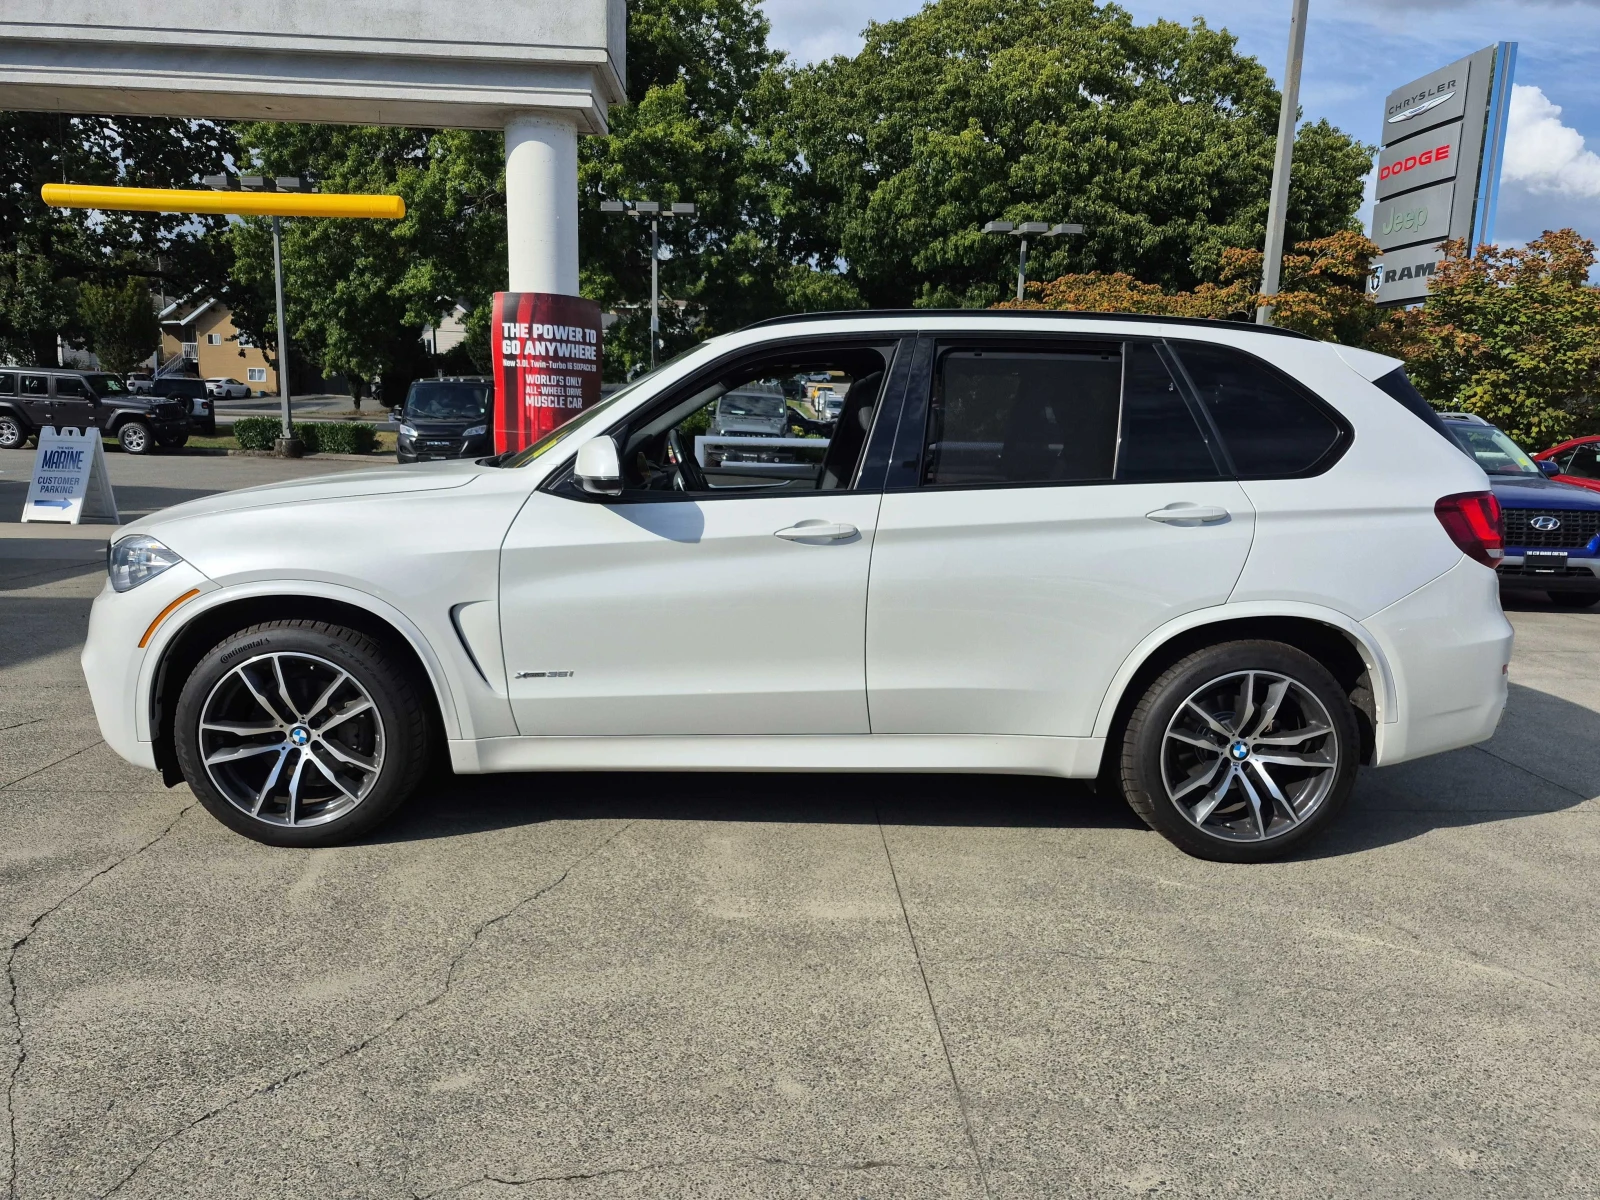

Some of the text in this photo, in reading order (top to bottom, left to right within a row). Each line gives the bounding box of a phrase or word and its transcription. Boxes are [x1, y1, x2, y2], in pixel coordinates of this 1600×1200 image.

[1388, 79, 1457, 115] CHRYSLER
[1380, 144, 1451, 180] DODGE
[1382, 206, 1428, 235] Jeep
[1384, 262, 1436, 283] RAM
[502, 322, 597, 343] THE POWER TO
[502, 340, 597, 360] GO ANYWHERE
[503, 359, 516, 367] New
[516, 359, 529, 368] 3.0L
[530, 359, 567, 370] Twin-Turbo
[525, 374, 582, 387] WORLD'S ONLY
[526, 385, 565, 395] ALL-WHEEL
[525, 395, 583, 409] MUSCLE CAR
[42, 450, 84, 469] MARINE
[38, 476, 80, 486] CUSTOMER
[40, 485, 74, 494] PARKING
